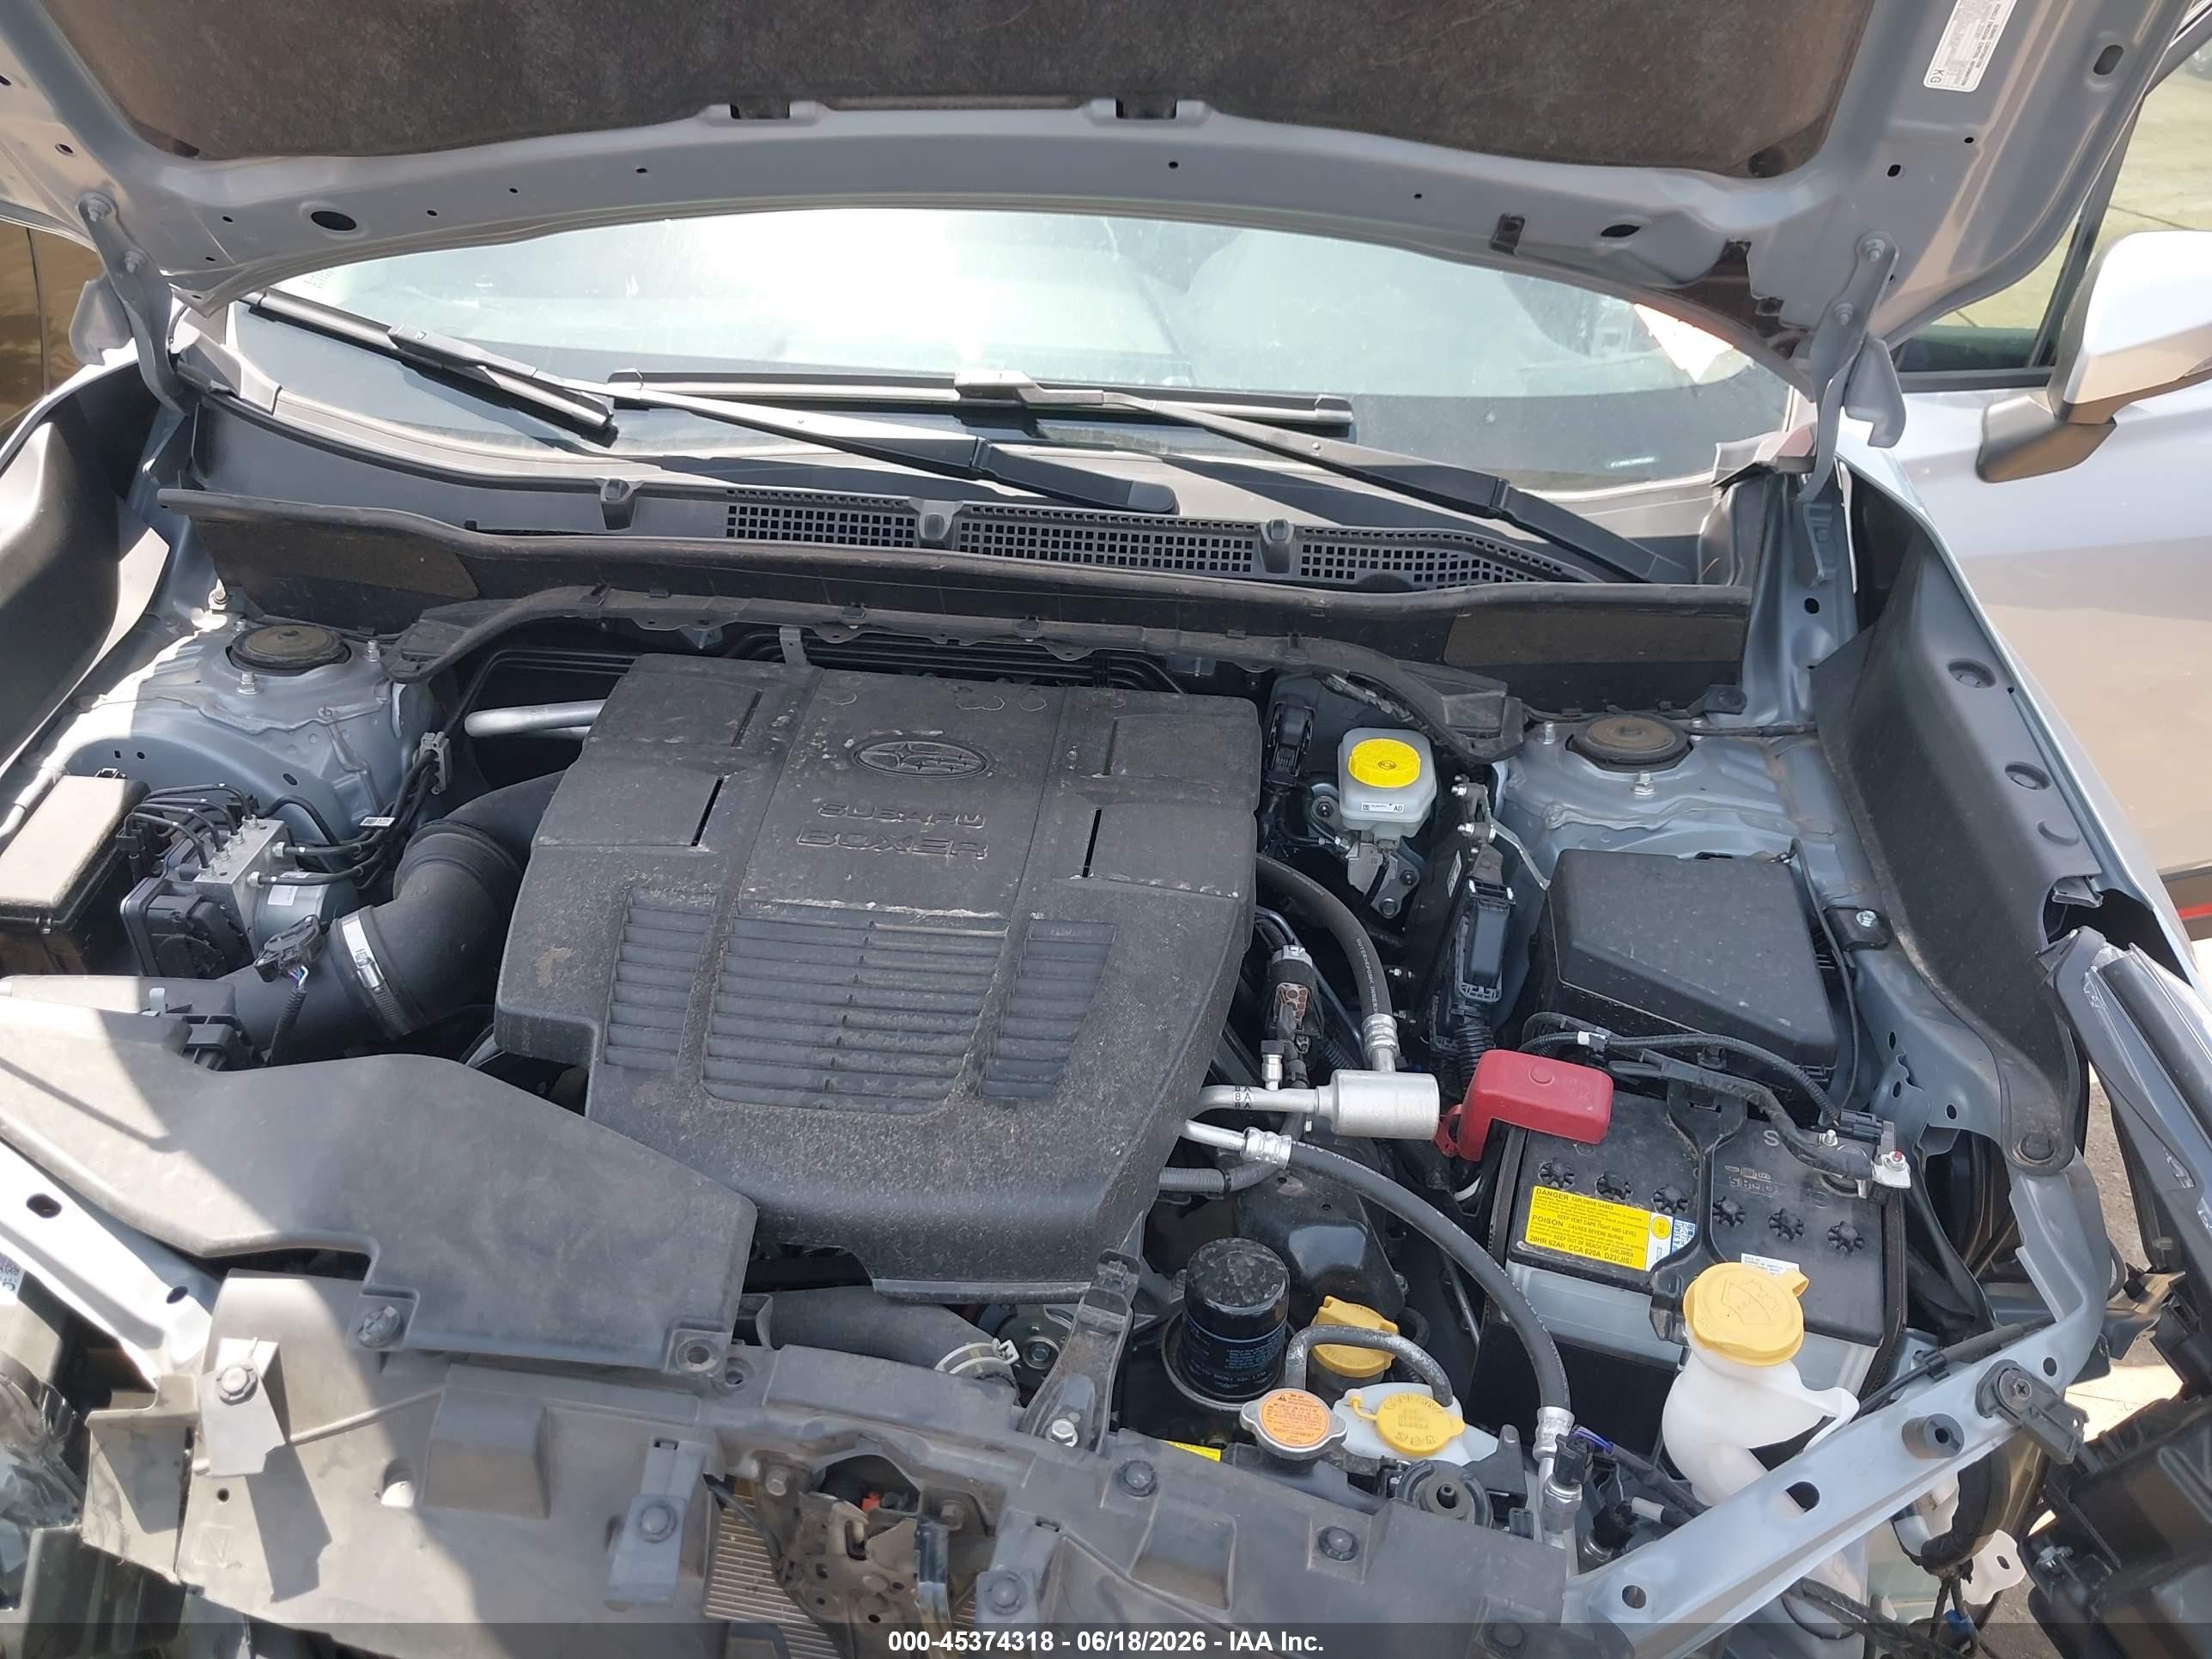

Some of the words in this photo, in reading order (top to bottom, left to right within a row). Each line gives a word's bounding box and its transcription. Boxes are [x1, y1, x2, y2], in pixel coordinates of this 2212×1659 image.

[1930, 69, 1945, 83] KG
[818, 803, 985, 829] SUBARU
[797, 830, 988, 860] BOXER
[1536, 1188, 1569, 1201] DANGER
[1531, 1215, 1563, 1227] POISON
[1529, 1235, 1547, 1244] 20HR
[1548, 1240, 1565, 1248] 62Ah
[1568, 1244, 1582, 1252] CCA
[1584, 1248, 1601, 1257] 620A
